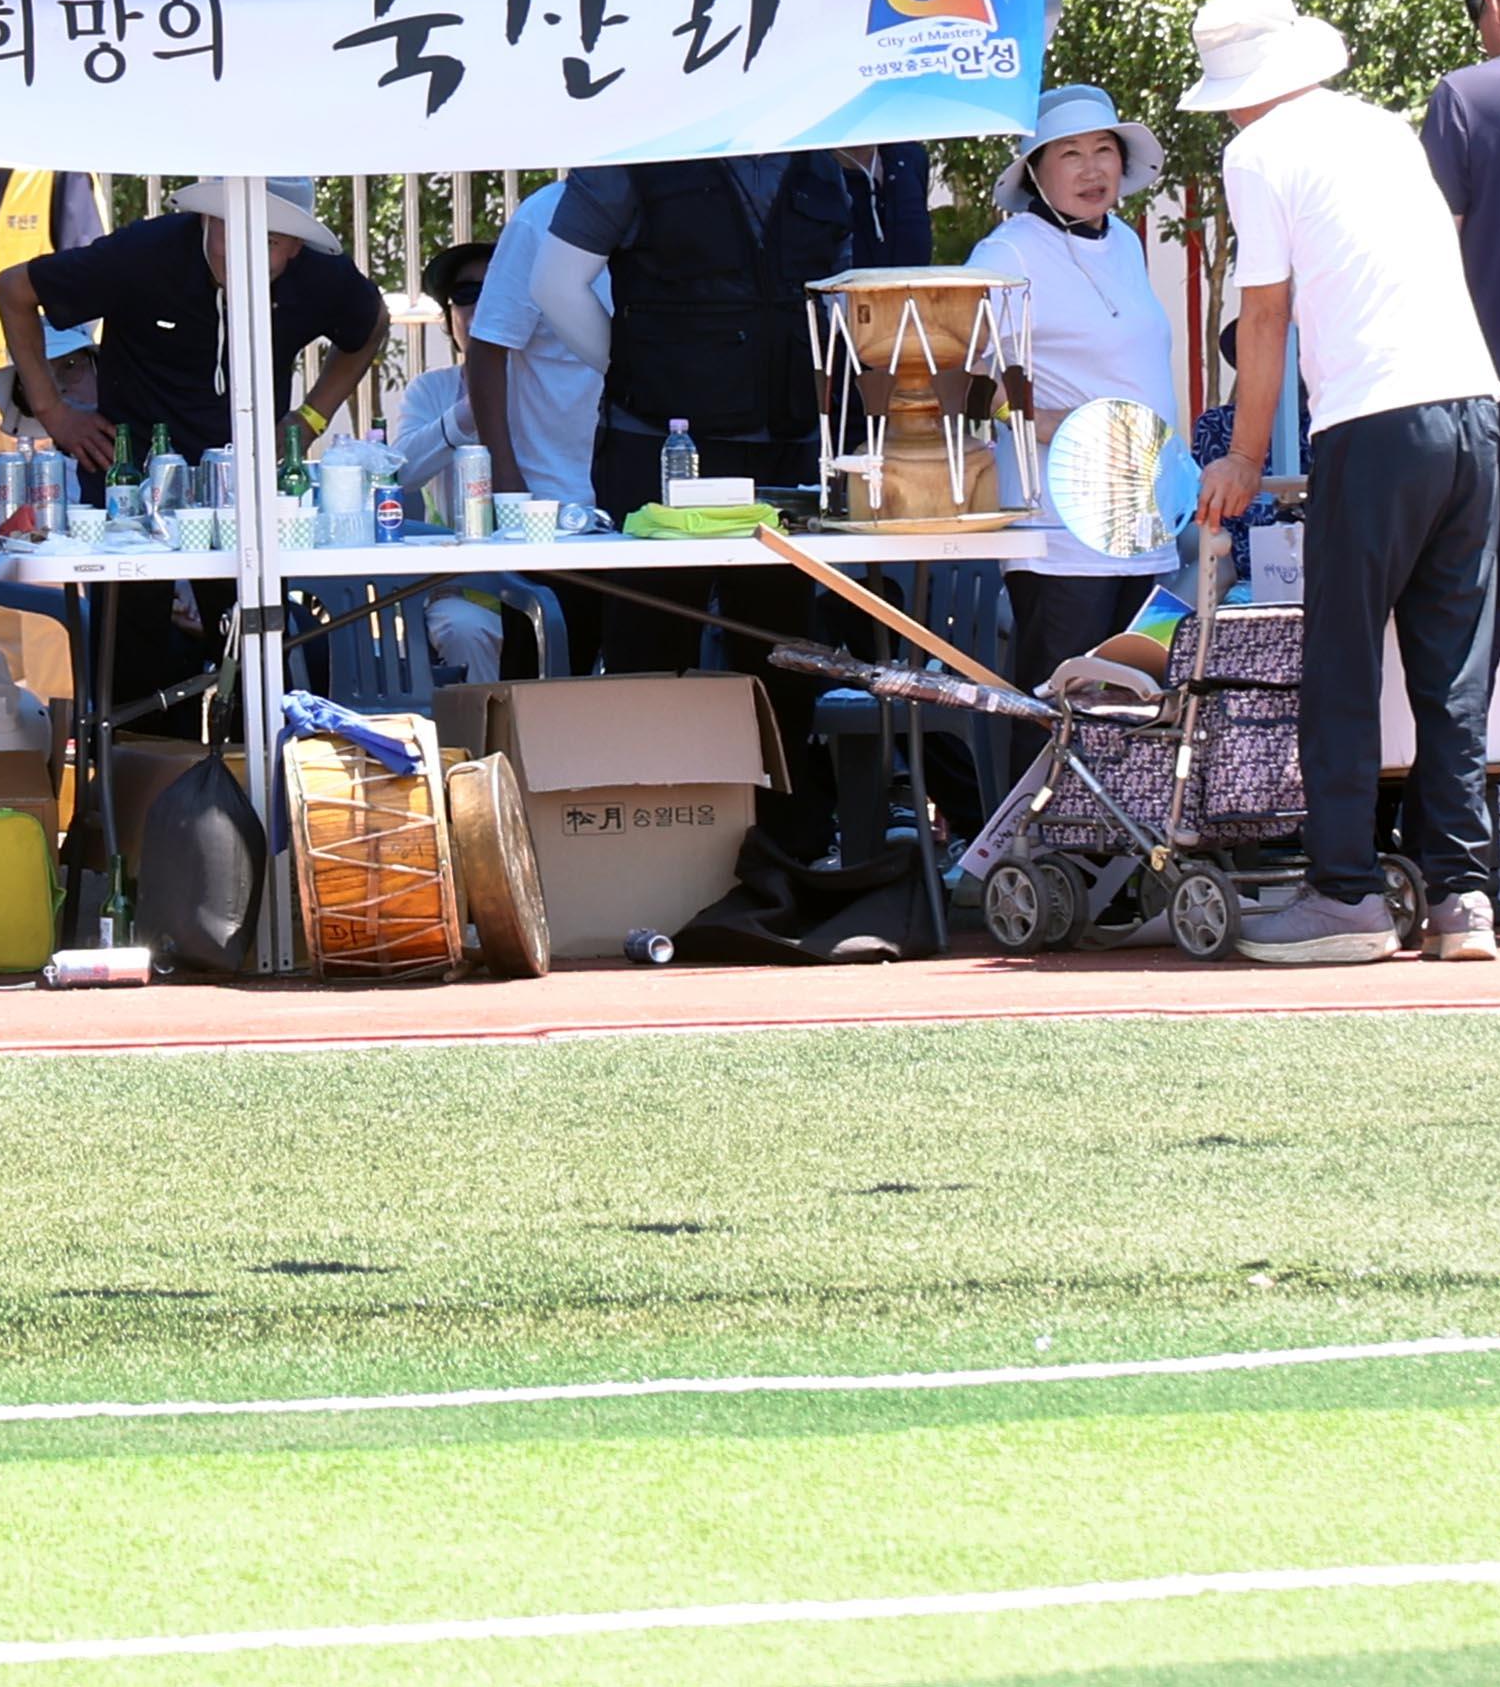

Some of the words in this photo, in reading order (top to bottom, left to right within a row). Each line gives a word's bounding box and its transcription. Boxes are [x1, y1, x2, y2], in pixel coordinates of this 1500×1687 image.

[951, 43, 1015, 75] 안성
[566, 807, 623, 833] 松月
[633, 804, 716, 828] 송월타올
